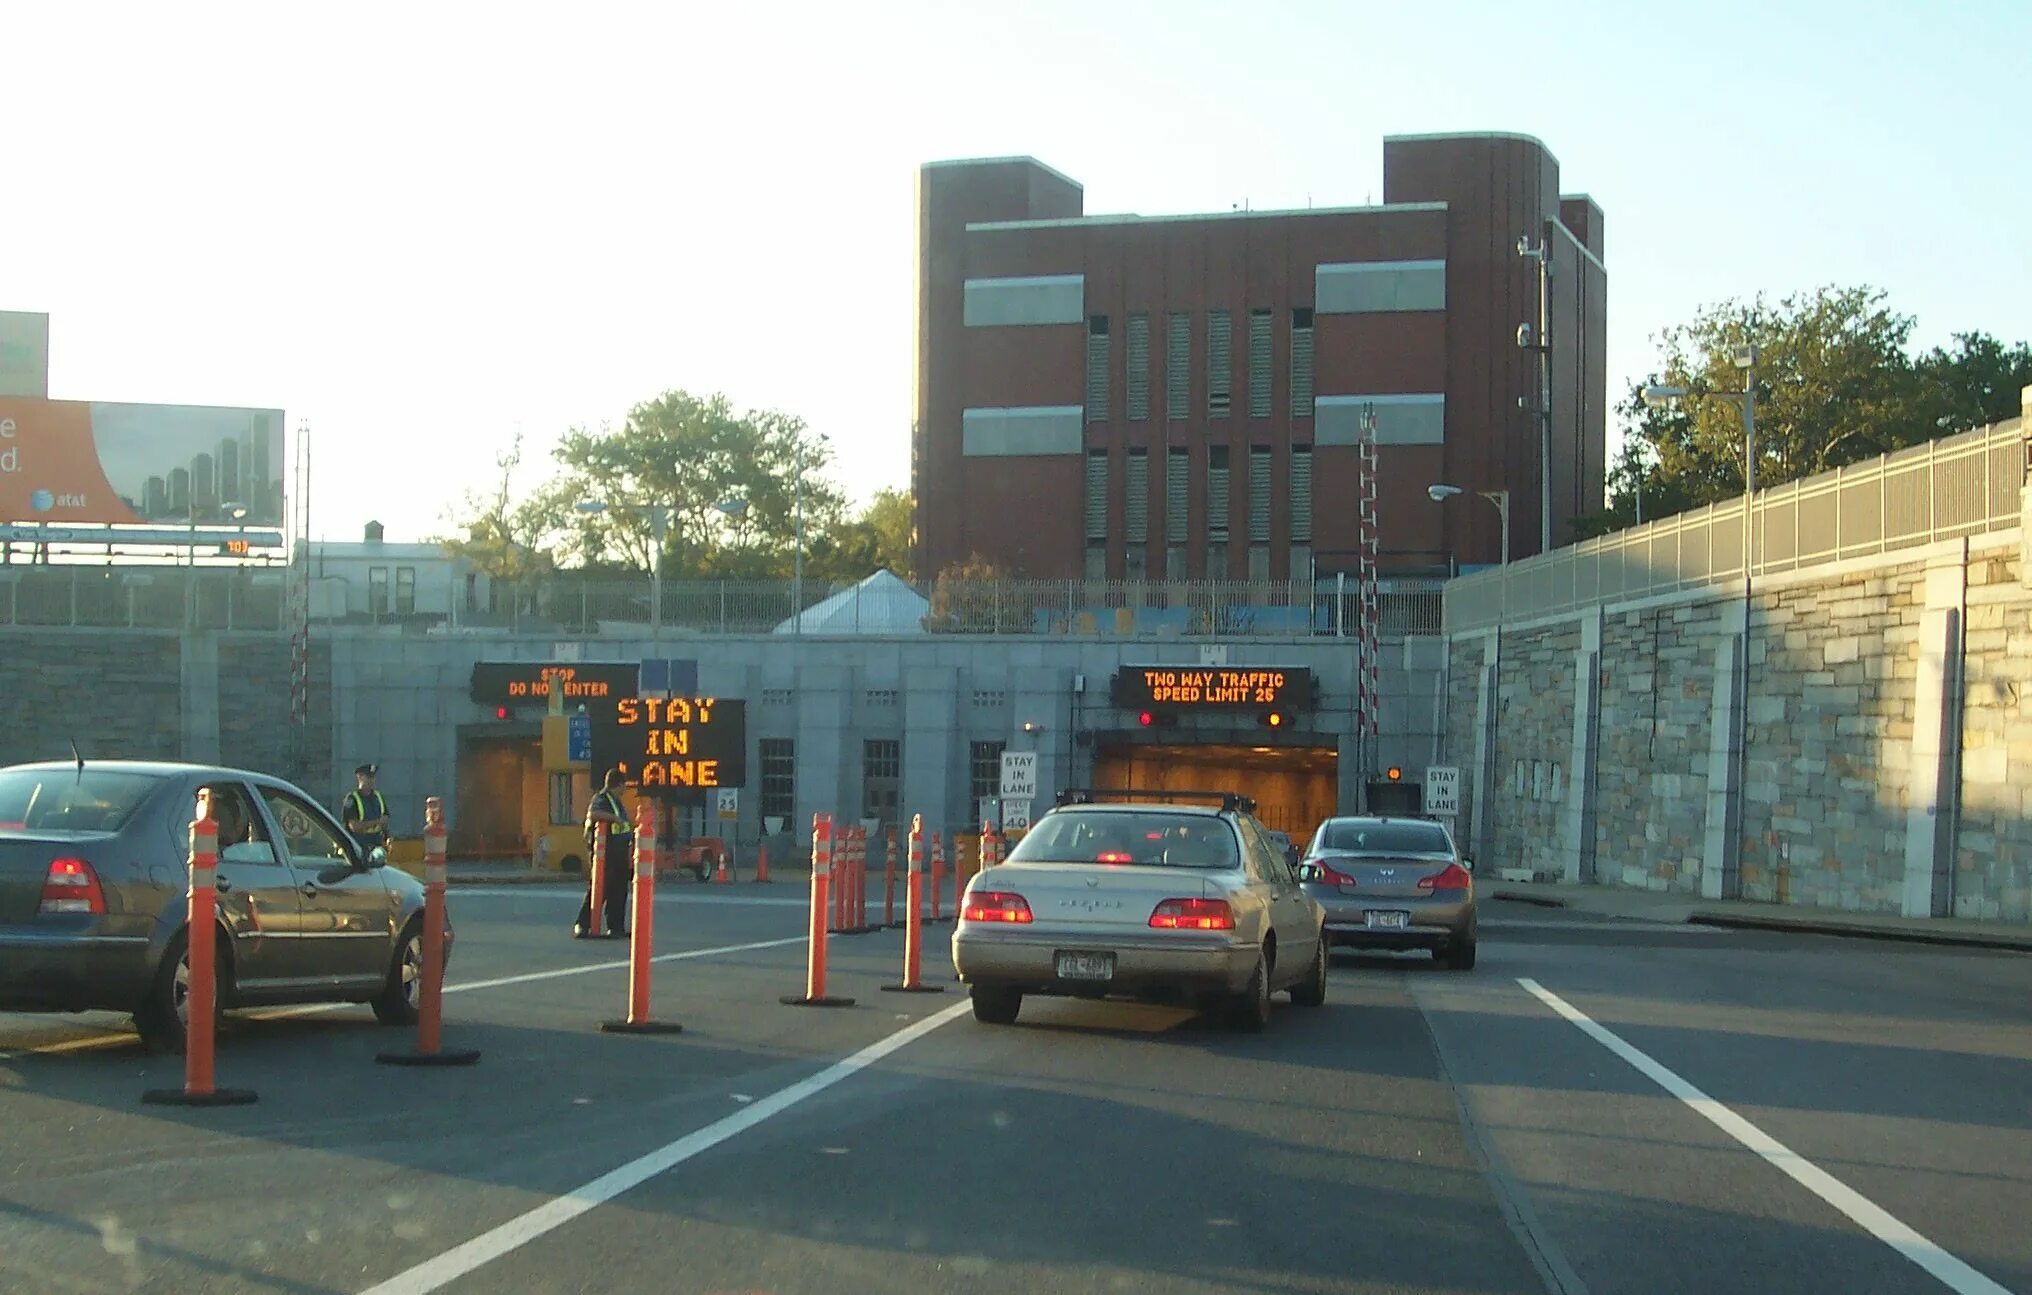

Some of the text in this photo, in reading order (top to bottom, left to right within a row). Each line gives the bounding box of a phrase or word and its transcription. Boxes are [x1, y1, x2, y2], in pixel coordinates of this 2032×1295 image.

[541, 667, 576, 681] STOP
[1144, 671, 1284, 688] TWO WAY TRAFFIC
[509, 681, 608, 697] DO NO ENTER
[1153, 686, 1200, 702] SPEED
[1205, 686, 1249, 702] LIMIT
[618, 698, 714, 724] STAY
[646, 729, 688, 755] IN
[1005, 756, 1034, 767] STAY
[1012, 770, 1025, 780] IN
[1430, 771, 1456, 782] STAY
[1002, 783, 1034, 794] LANE
[1436, 785, 1449, 796] IN
[1428, 799, 1457, 811] LANE
